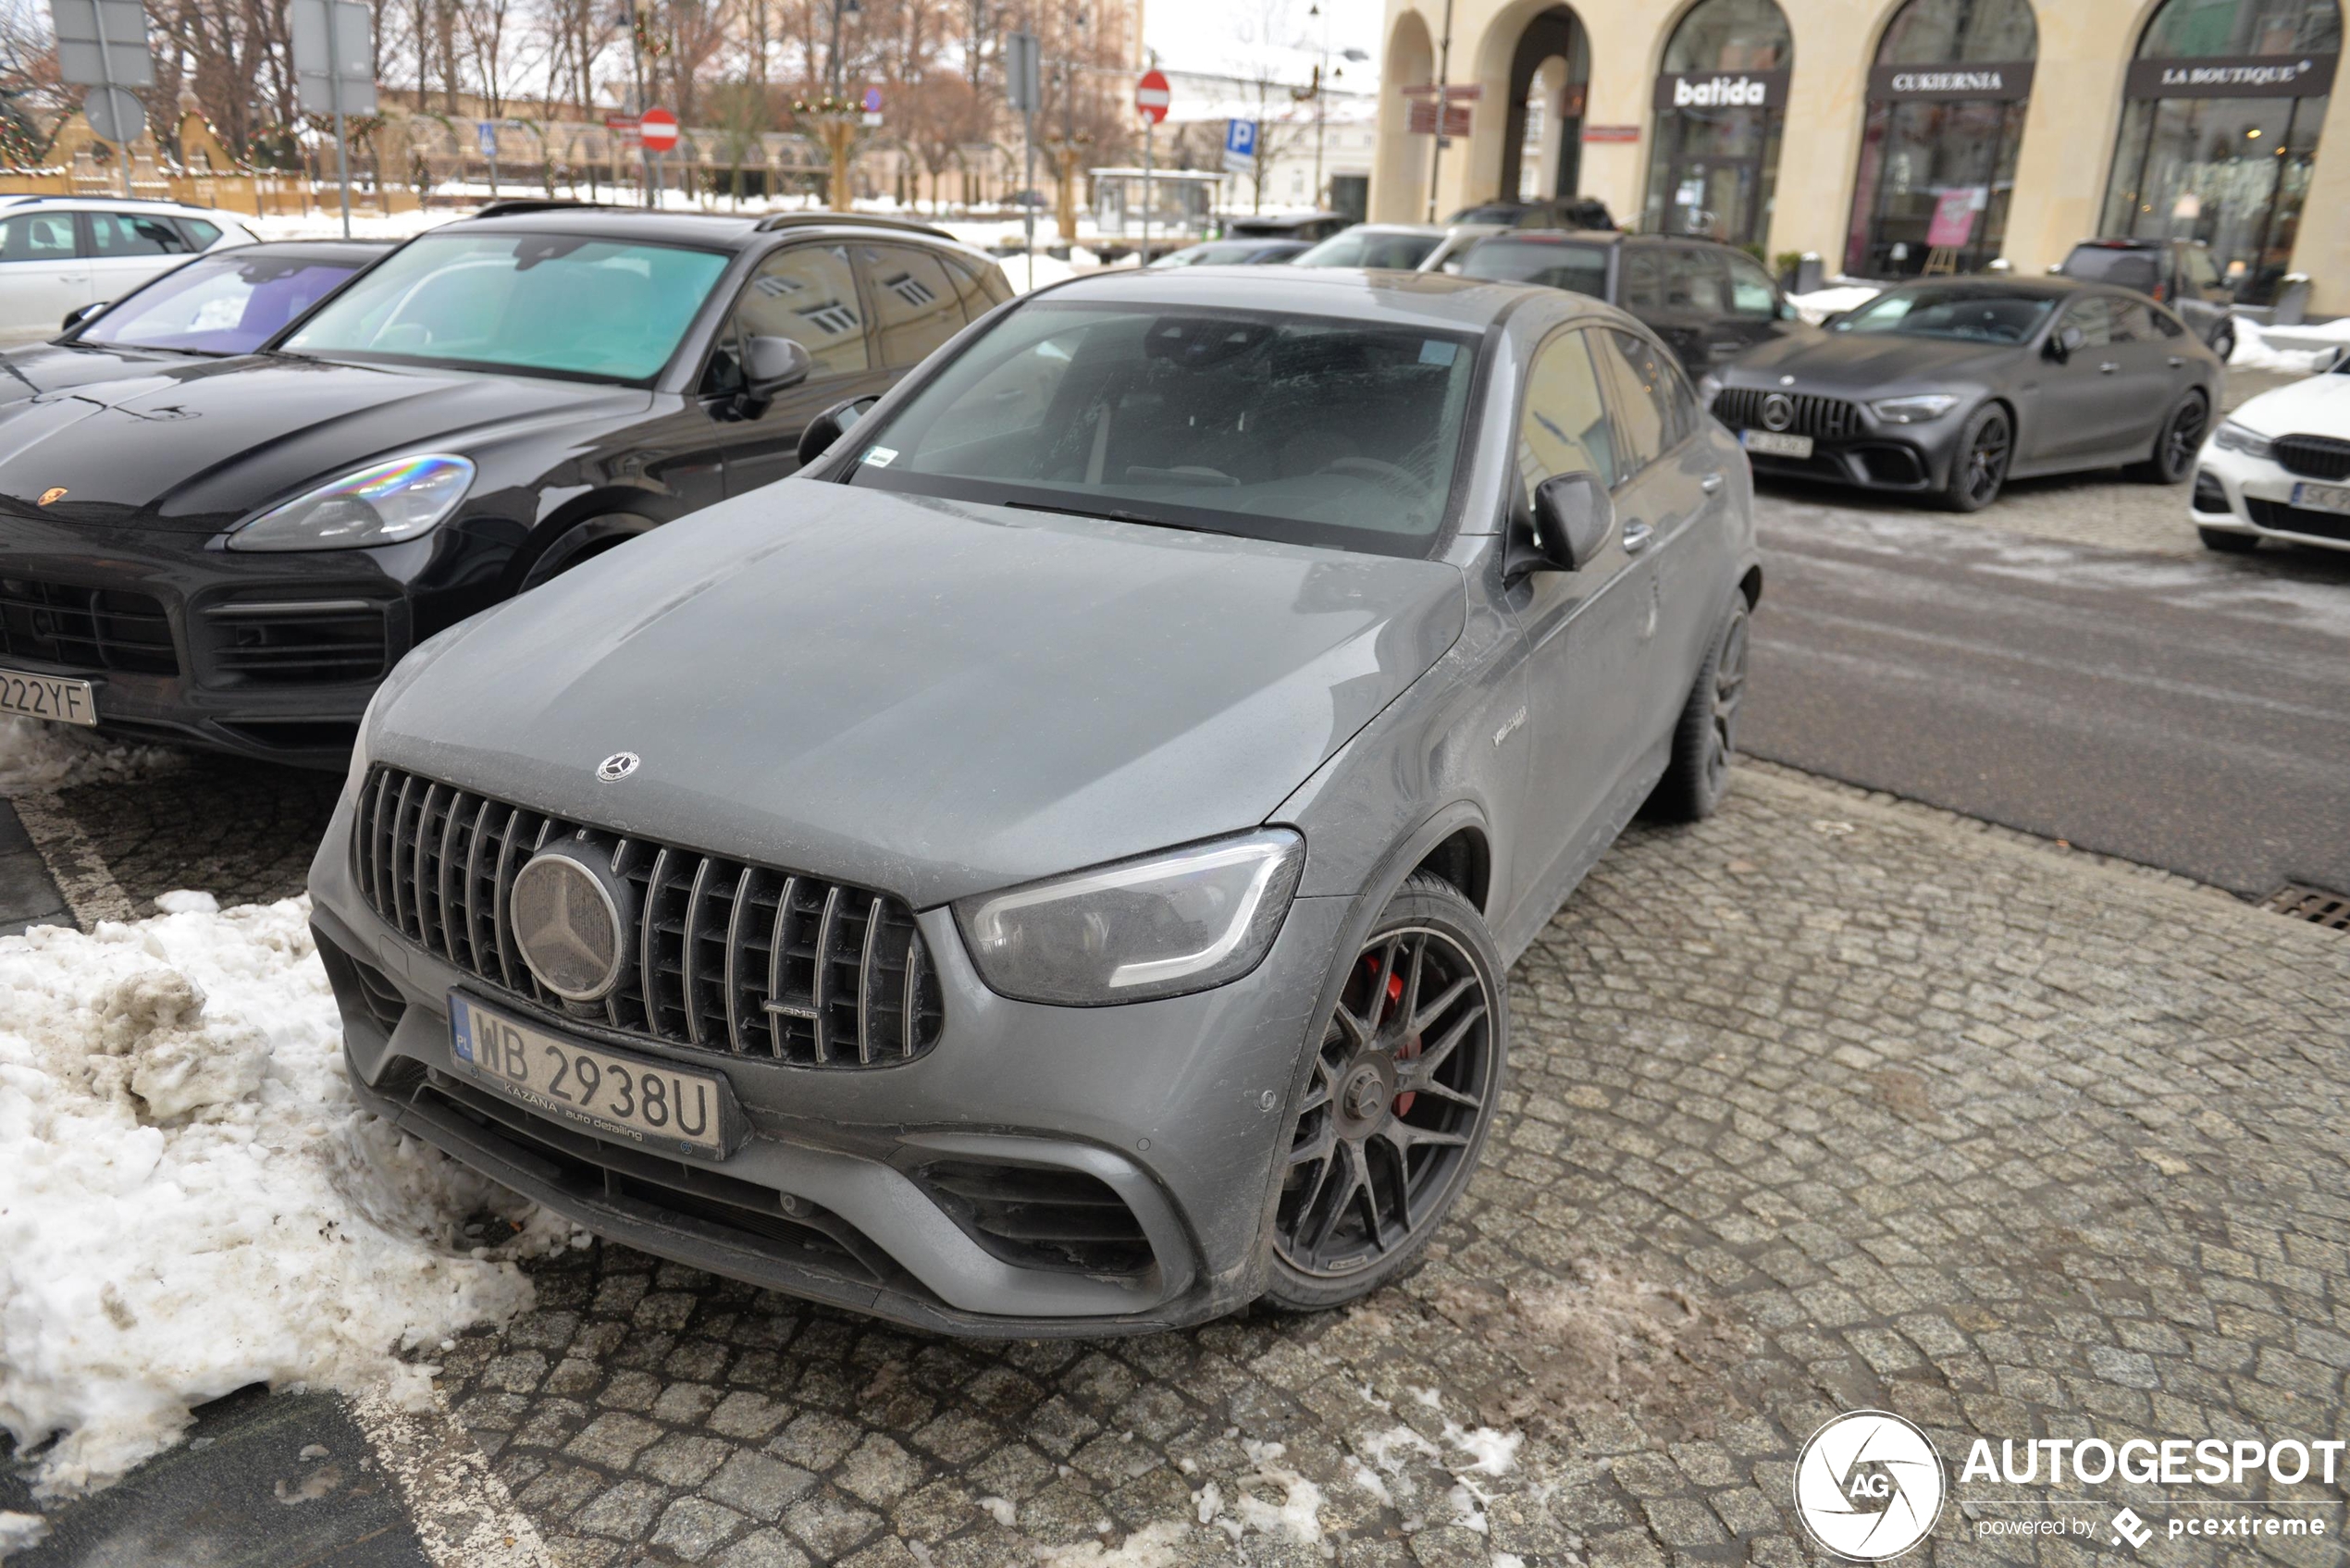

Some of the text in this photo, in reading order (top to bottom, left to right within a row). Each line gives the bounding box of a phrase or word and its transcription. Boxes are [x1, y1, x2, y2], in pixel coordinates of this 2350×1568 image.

[1674, 76, 1766, 106] batida
[1891, 71, 2002, 92] CUKIERNIA
[1231, 122, 1253, 150] P
[782, 1006, 817, 1019] AMG
[456, 1034, 470, 1052] PL
[476, 1011, 707, 1136] WB 2938U
[504, 1082, 643, 1142] KAZANA auto detailing
